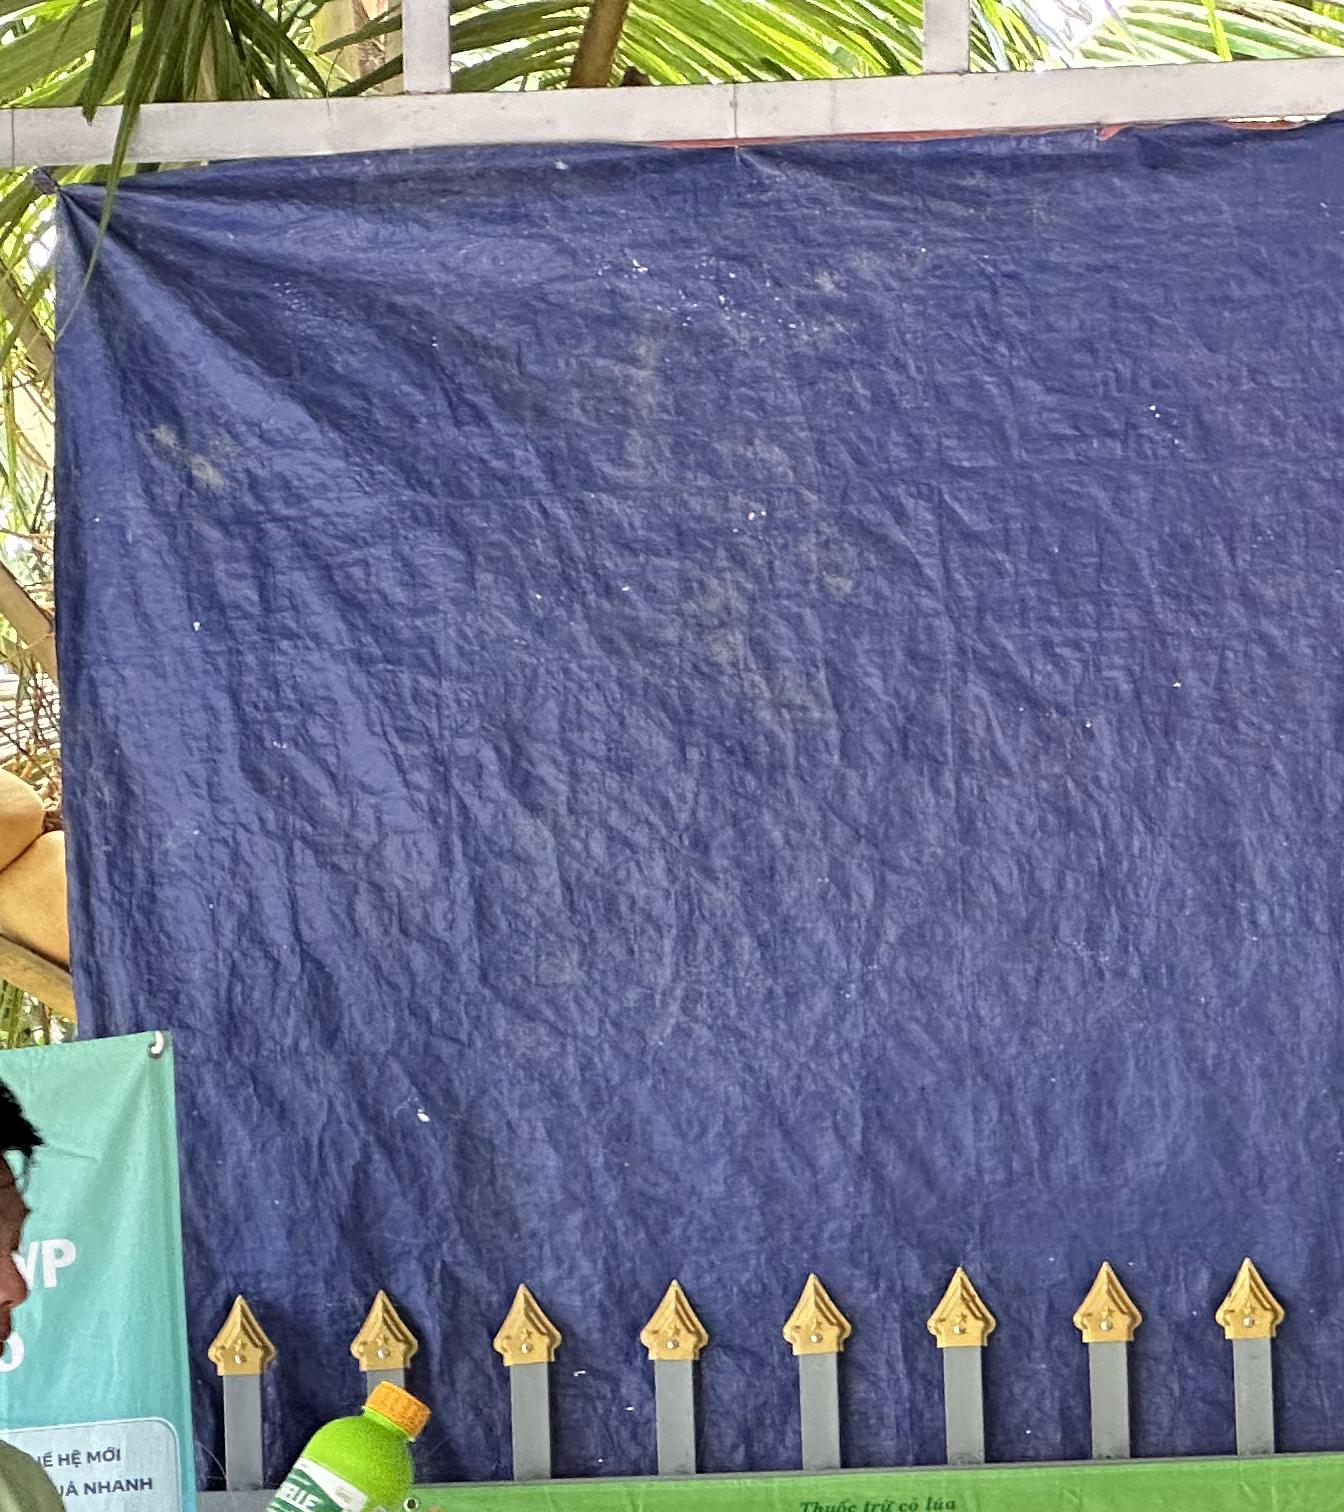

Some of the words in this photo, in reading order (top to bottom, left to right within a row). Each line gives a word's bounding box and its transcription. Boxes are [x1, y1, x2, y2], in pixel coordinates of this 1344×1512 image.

[58, 1449, 82, 1468] HỆ
[87, 1446, 121, 1464] MỚI
[84, 1477, 153, 1496] NHANH
[926, 1494, 956, 1512] lúa
